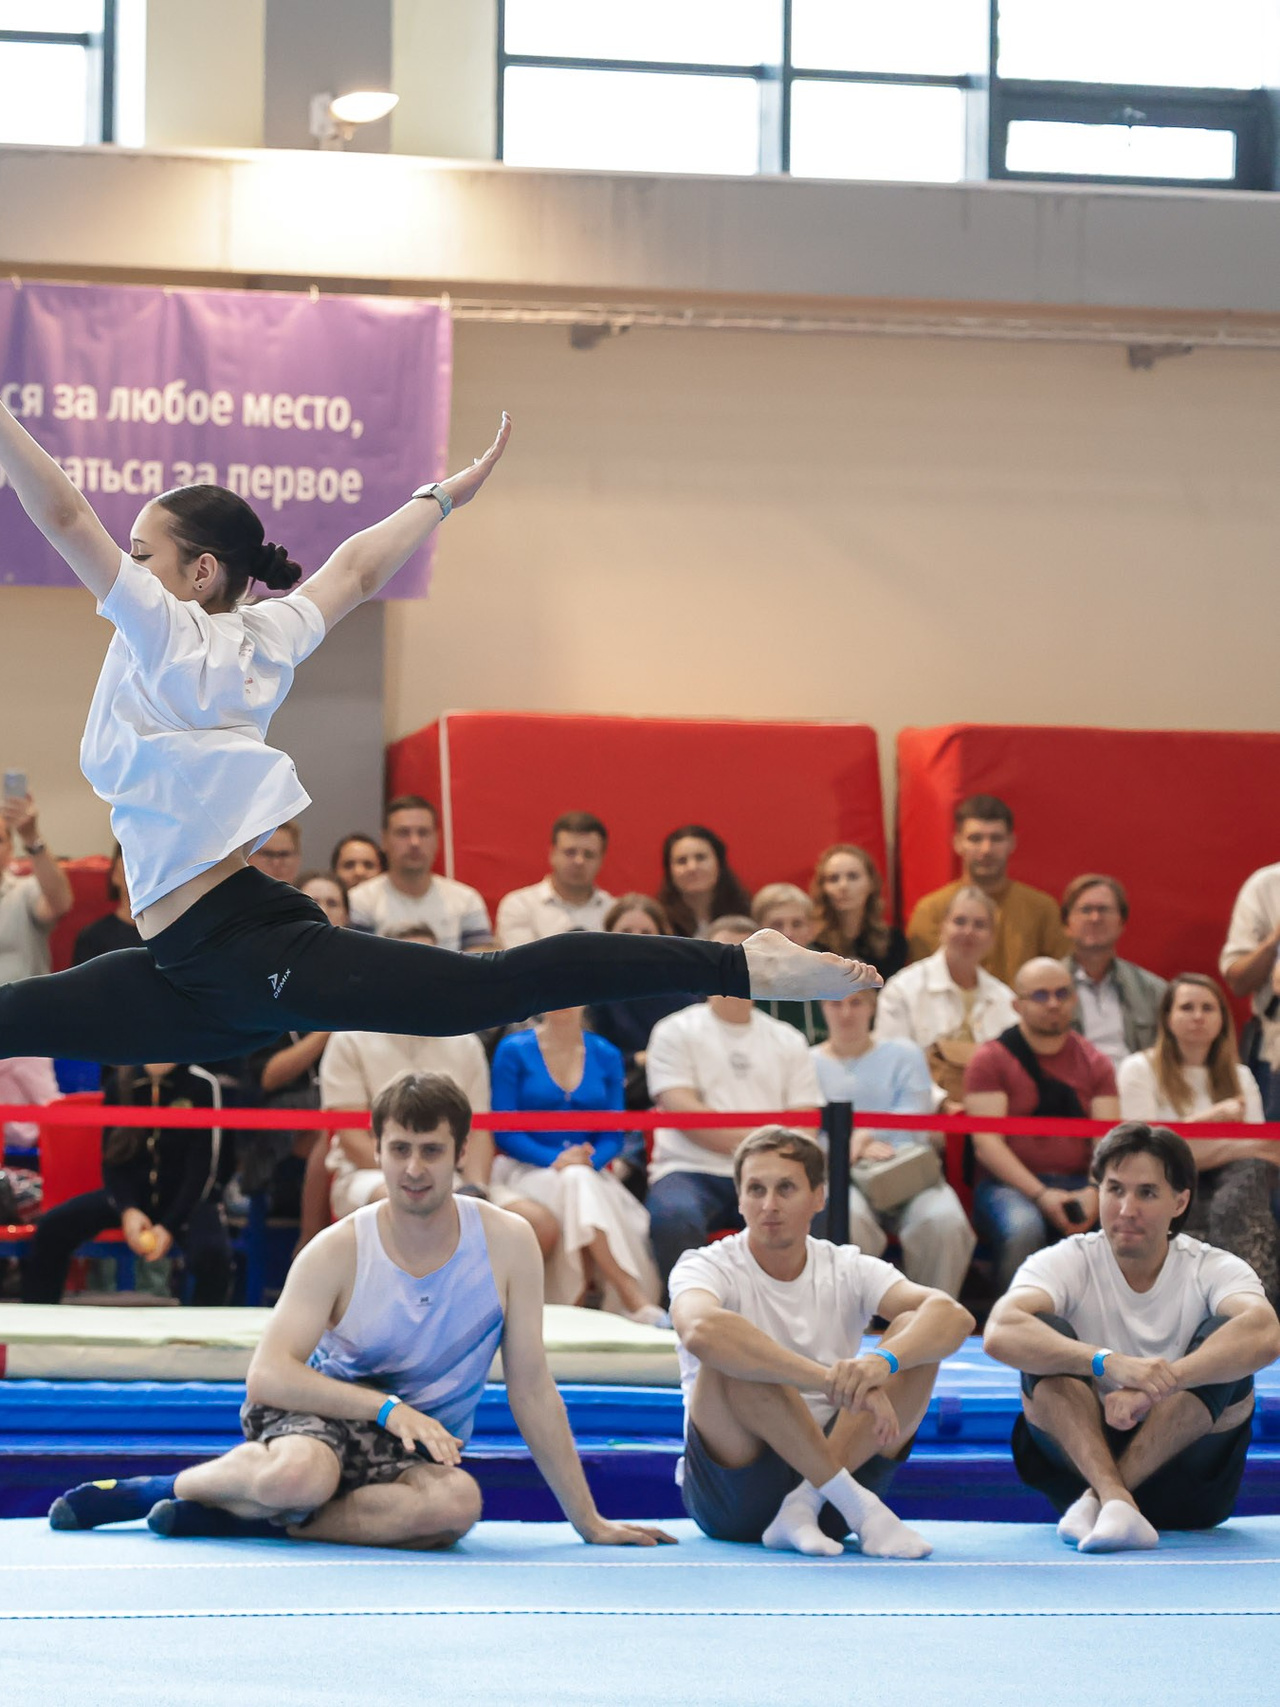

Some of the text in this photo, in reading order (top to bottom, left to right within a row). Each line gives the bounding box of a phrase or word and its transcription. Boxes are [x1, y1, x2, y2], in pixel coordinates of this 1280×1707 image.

[52, 383, 98, 420] за
[106, 380, 234, 426] любое
[242, 388, 364, 439] место,
[170, 461, 218, 487] за
[226, 462, 364, 511] первое
